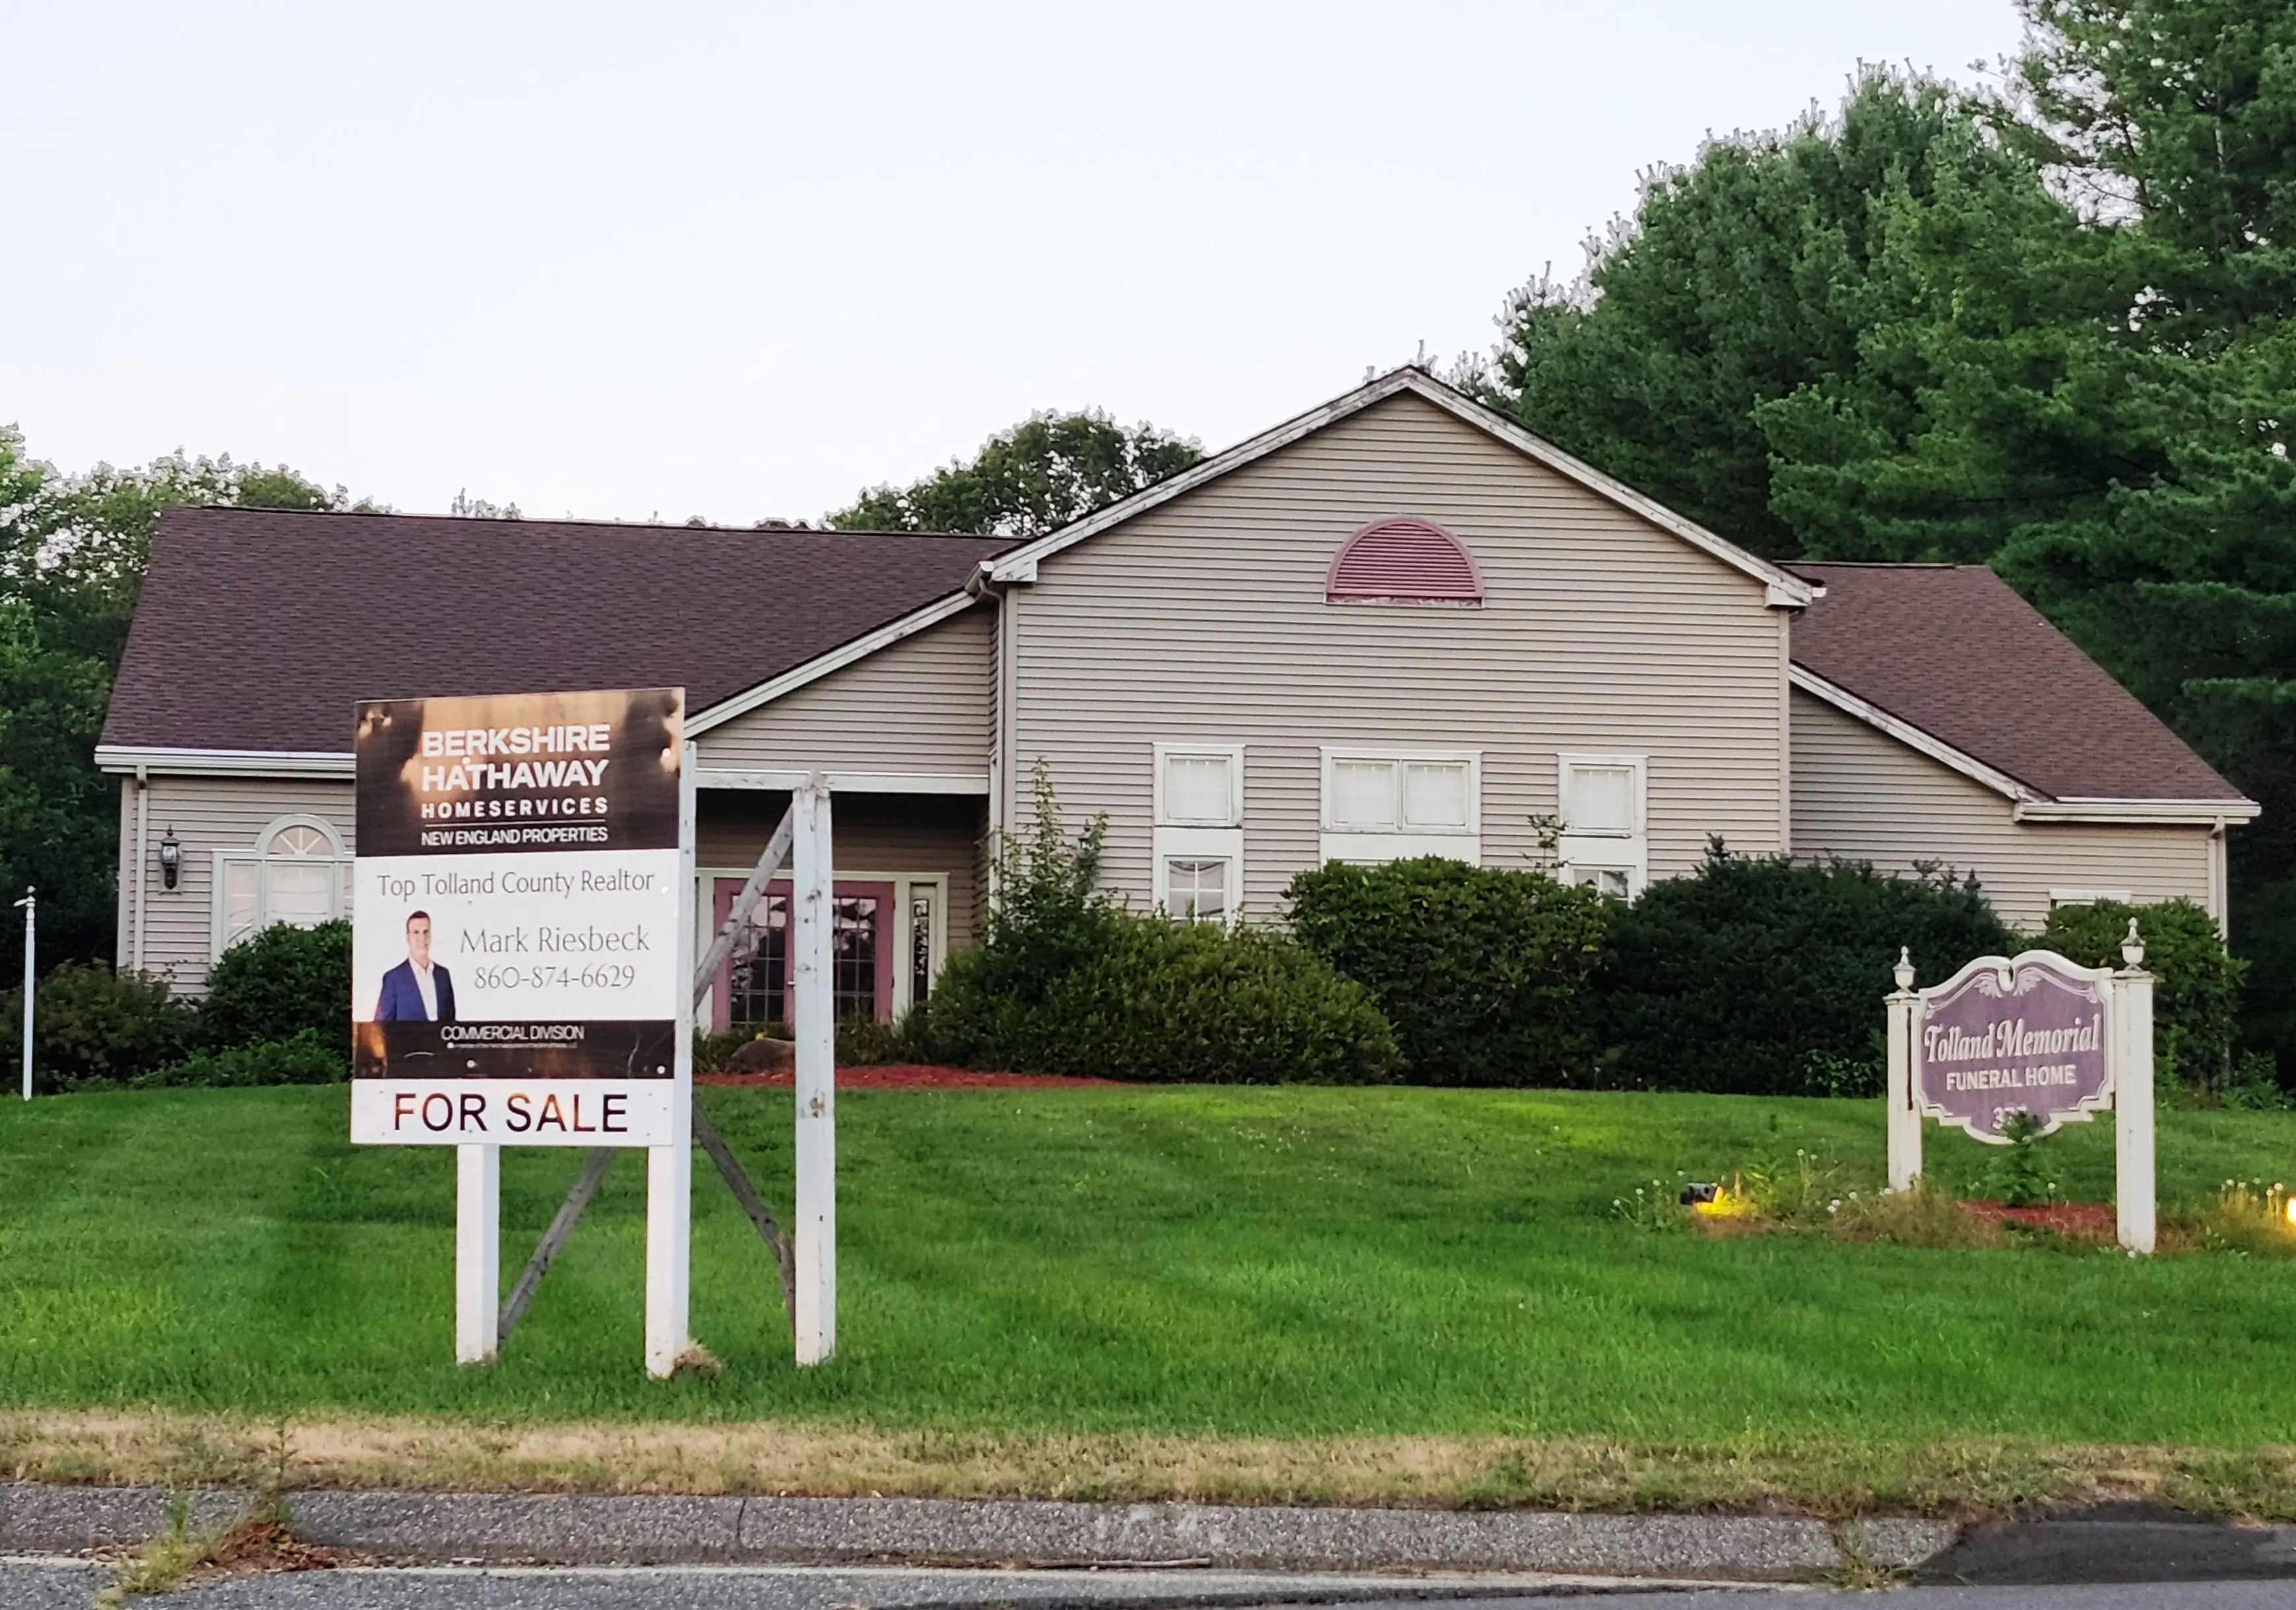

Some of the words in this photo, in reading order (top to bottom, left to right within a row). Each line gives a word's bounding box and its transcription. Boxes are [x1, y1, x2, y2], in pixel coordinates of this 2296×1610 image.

[421, 724, 611, 758] BERKSHIRE
[421, 759, 610, 792] HATHAWAY
[421, 797, 609, 819] HOMESERVICES
[421, 831, 457, 846] NEW
[457, 829, 520, 845] ENGLAND
[522, 826, 609, 843] PROPERTIES
[377, 875, 416, 902] Top
[422, 872, 495, 895] Tolland
[501, 872, 575, 899] County
[581, 868, 655, 893] Realtor
[460, 926, 528, 954] Mark
[538, 925, 651, 952] Riesbeck
[474, 965, 635, 990] 860-874-6629
[441, 1025, 528, 1041] COMMERCIAL
[530, 1025, 585, 1041] DIVISION
[1924, 1023, 1994, 1064] Tolland
[1996, 1013, 2099, 1057] Memorial
[1946, 1070, 2022, 1091] FUNERAL
[2025, 1064, 2077, 1086] HOME
[395, 1093, 488, 1132] FOR
[505, 1093, 629, 1133] SALE
